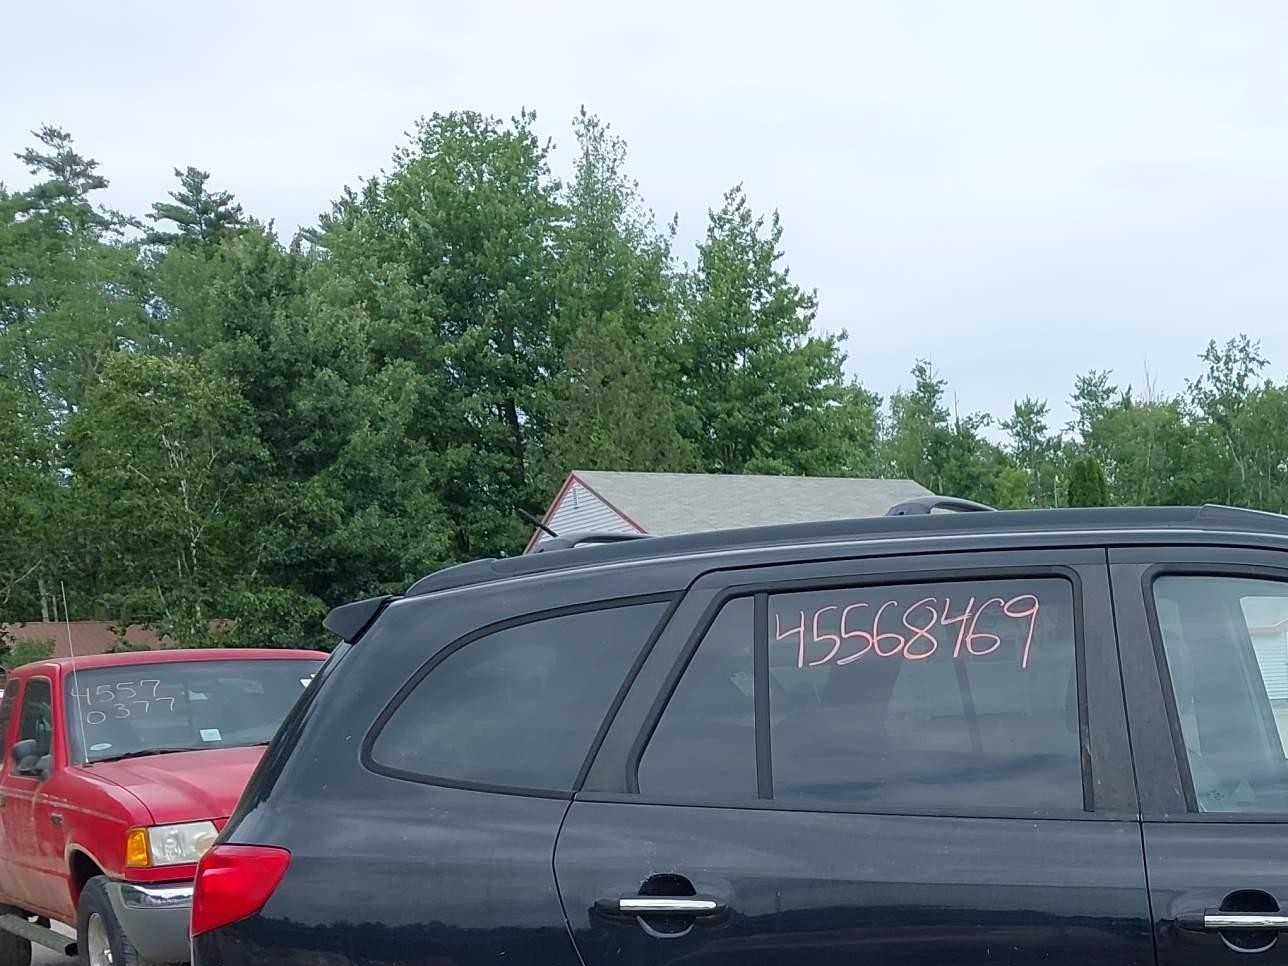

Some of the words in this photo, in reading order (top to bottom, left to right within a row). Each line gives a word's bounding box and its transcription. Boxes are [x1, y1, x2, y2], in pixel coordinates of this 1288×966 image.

[776, 594, 1040, 669] 45568469
[71, 679, 161, 705] 4557
[86, 697, 175, 725] 0377
